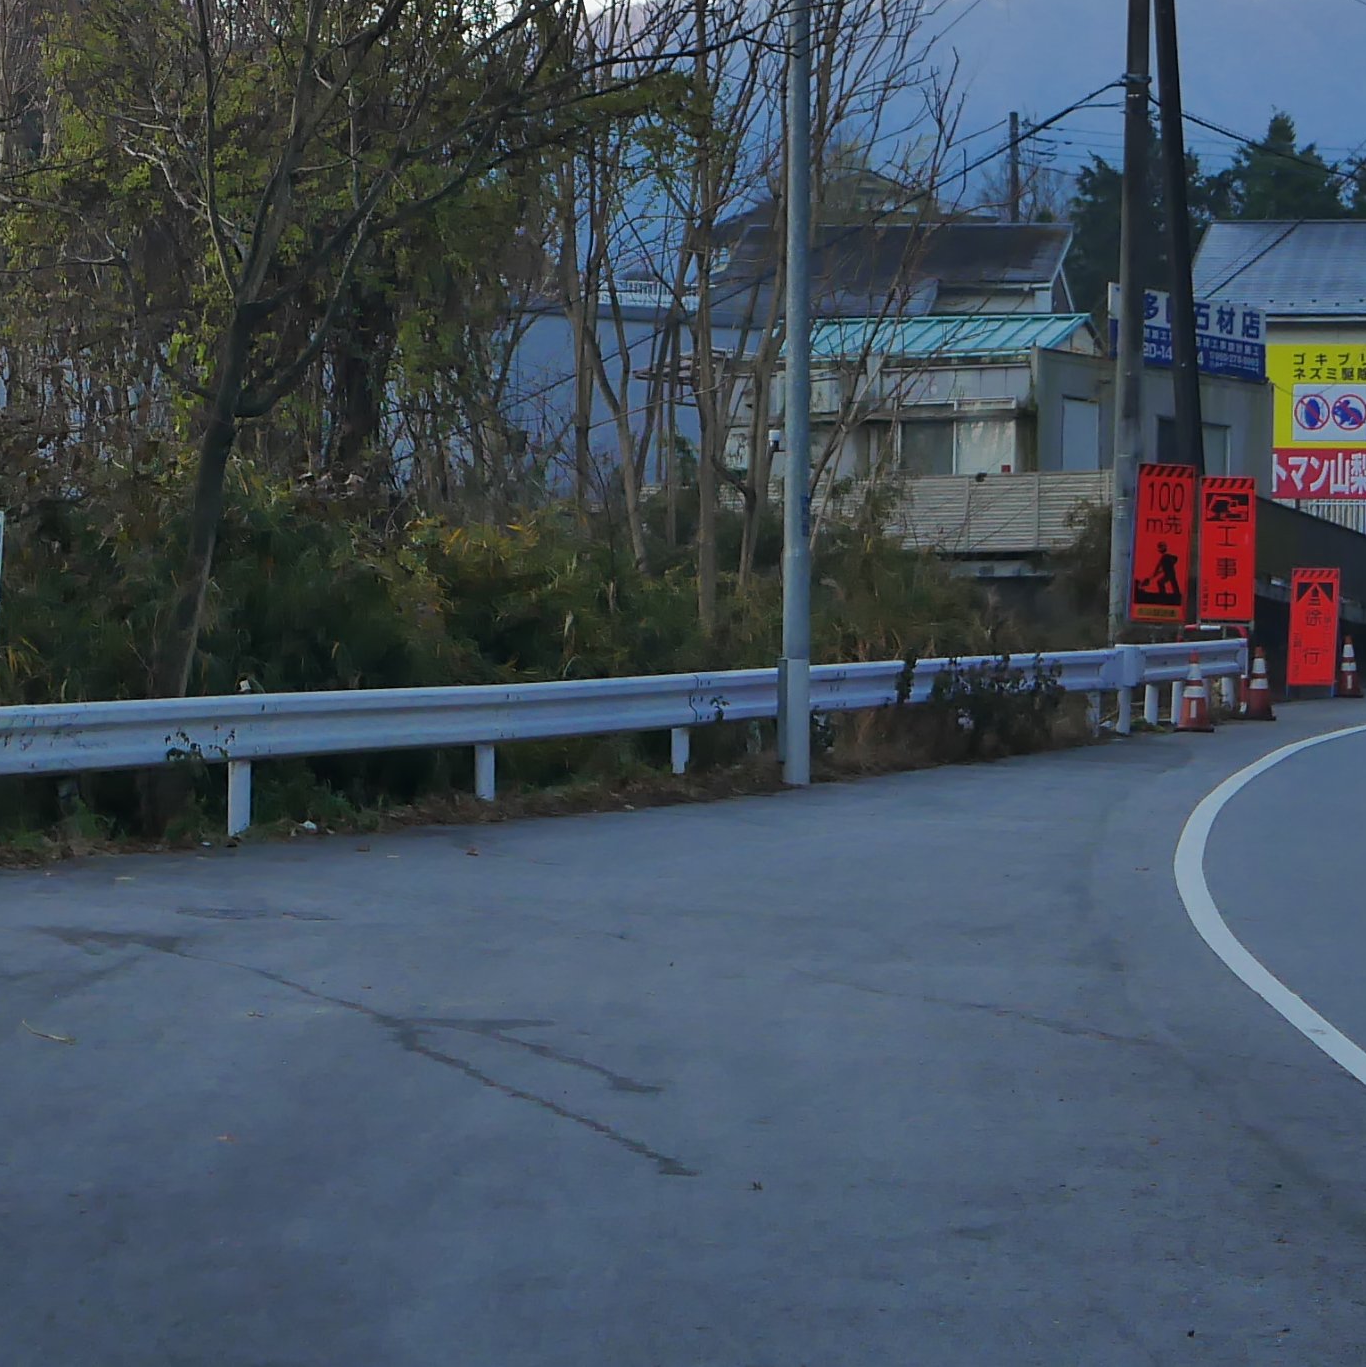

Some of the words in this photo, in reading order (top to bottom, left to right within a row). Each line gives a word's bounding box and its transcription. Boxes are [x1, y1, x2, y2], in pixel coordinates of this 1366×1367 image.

[1115, 287, 1261, 339] 多石材店
[1147, 482, 1185, 512] 100
[1146, 515, 1183, 535] m先
[1215, 525, 1238, 611] 工事中
